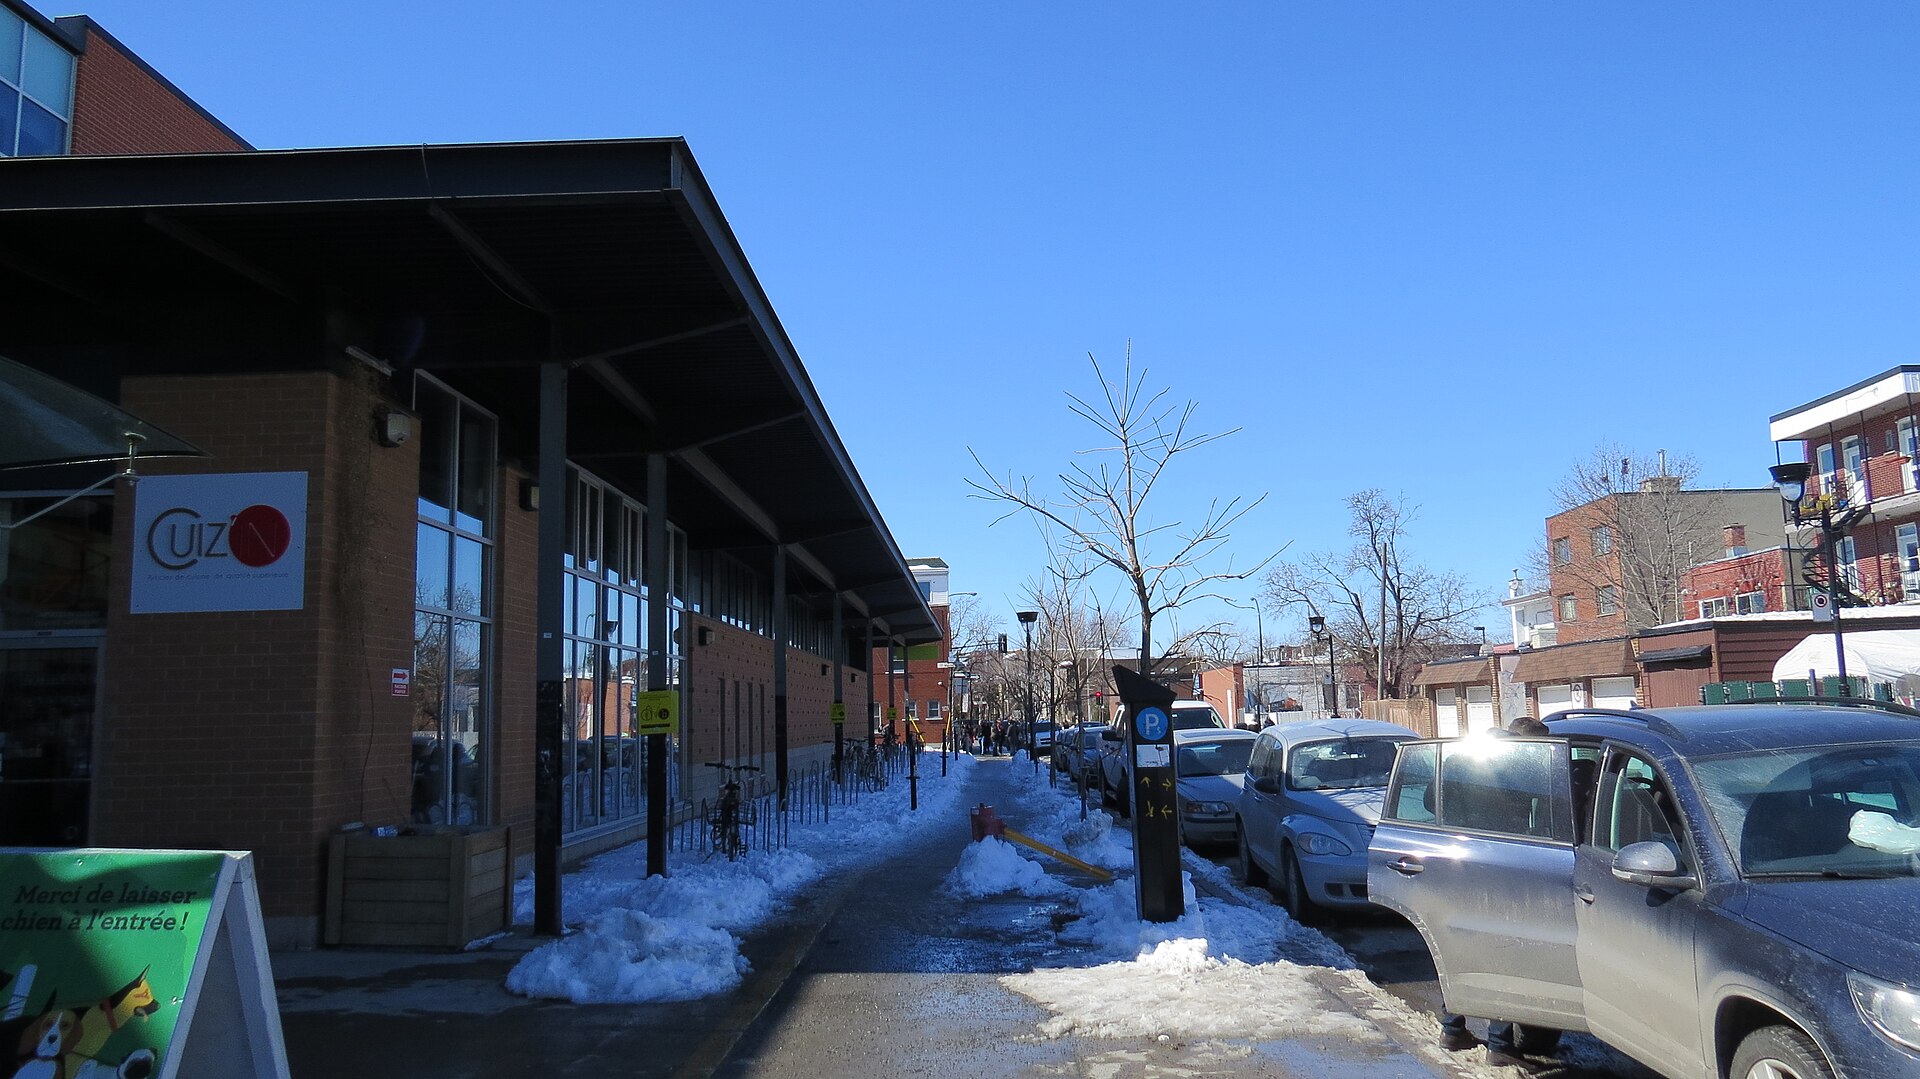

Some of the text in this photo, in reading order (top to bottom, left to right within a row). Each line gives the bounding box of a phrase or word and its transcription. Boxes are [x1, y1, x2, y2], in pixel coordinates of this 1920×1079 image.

[14, 882, 197, 904] Merci de laisser
[1, 909, 62, 931] chien
[67, 911, 81, 931] à
